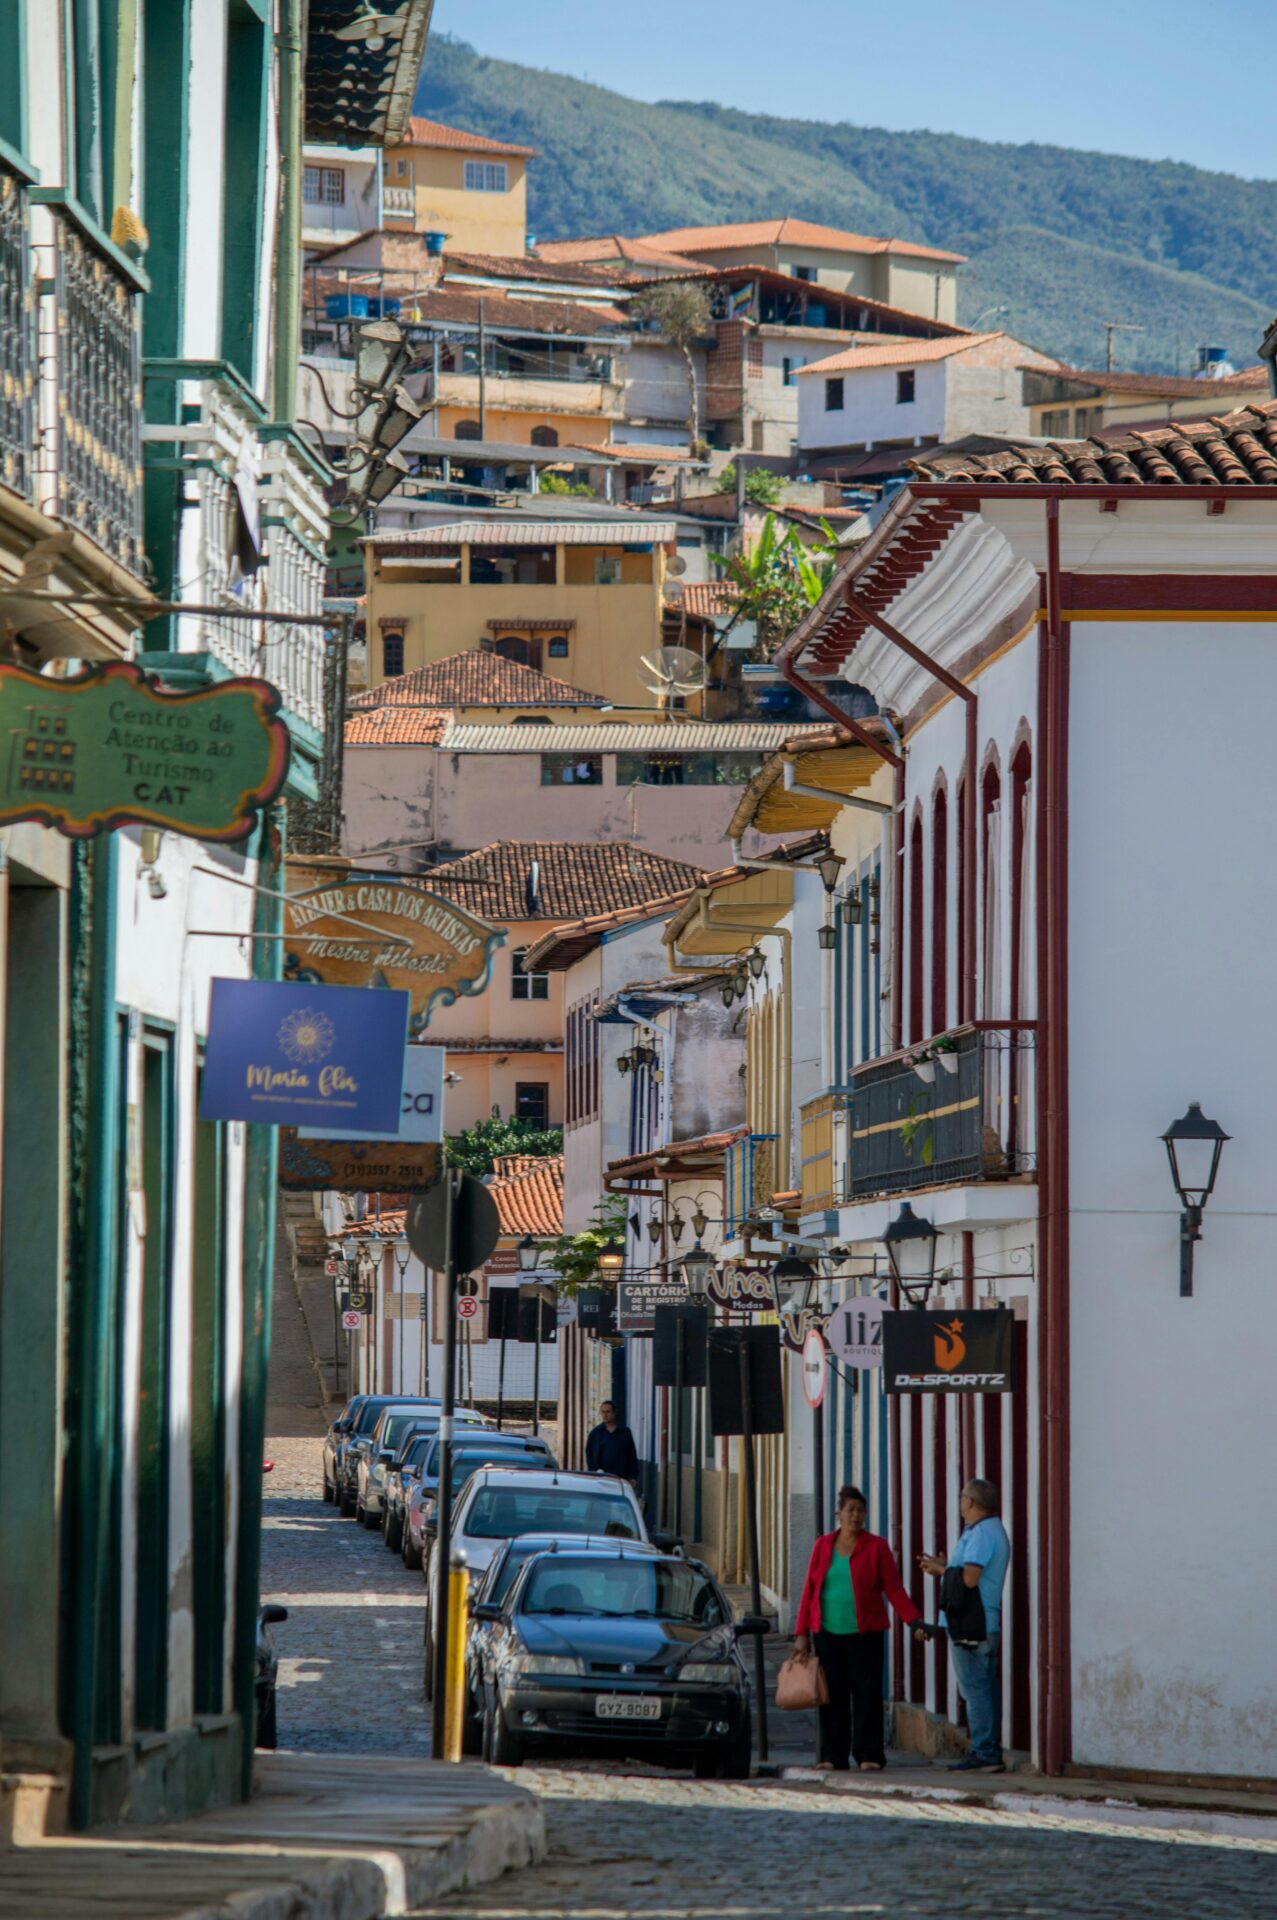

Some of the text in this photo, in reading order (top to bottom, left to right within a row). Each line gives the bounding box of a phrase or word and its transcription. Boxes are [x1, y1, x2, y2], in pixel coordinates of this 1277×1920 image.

[108, 700, 234, 734] Centro de
[104, 727, 233, 758] Atenção ao
[122, 753, 215, 783] Turismo
[133, 782, 191, 805] CAT
[287, 889, 347, 929] ATELIER
[357, 886, 393, 914] CASA
[393, 892, 425, 921] DOS
[419, 904, 481, 956] ARTISTAS
[246, 1064, 358, 1097] Maria Flor
[624, 1284, 690, 1297] CARTÓRIO
[705, 1265, 774, 1300] Viva
[645, 1296, 687, 1304] REGISTRO
[732, 1300, 764, 1309] Modas
[894, 1373, 1006, 1386] DESPORTZ
